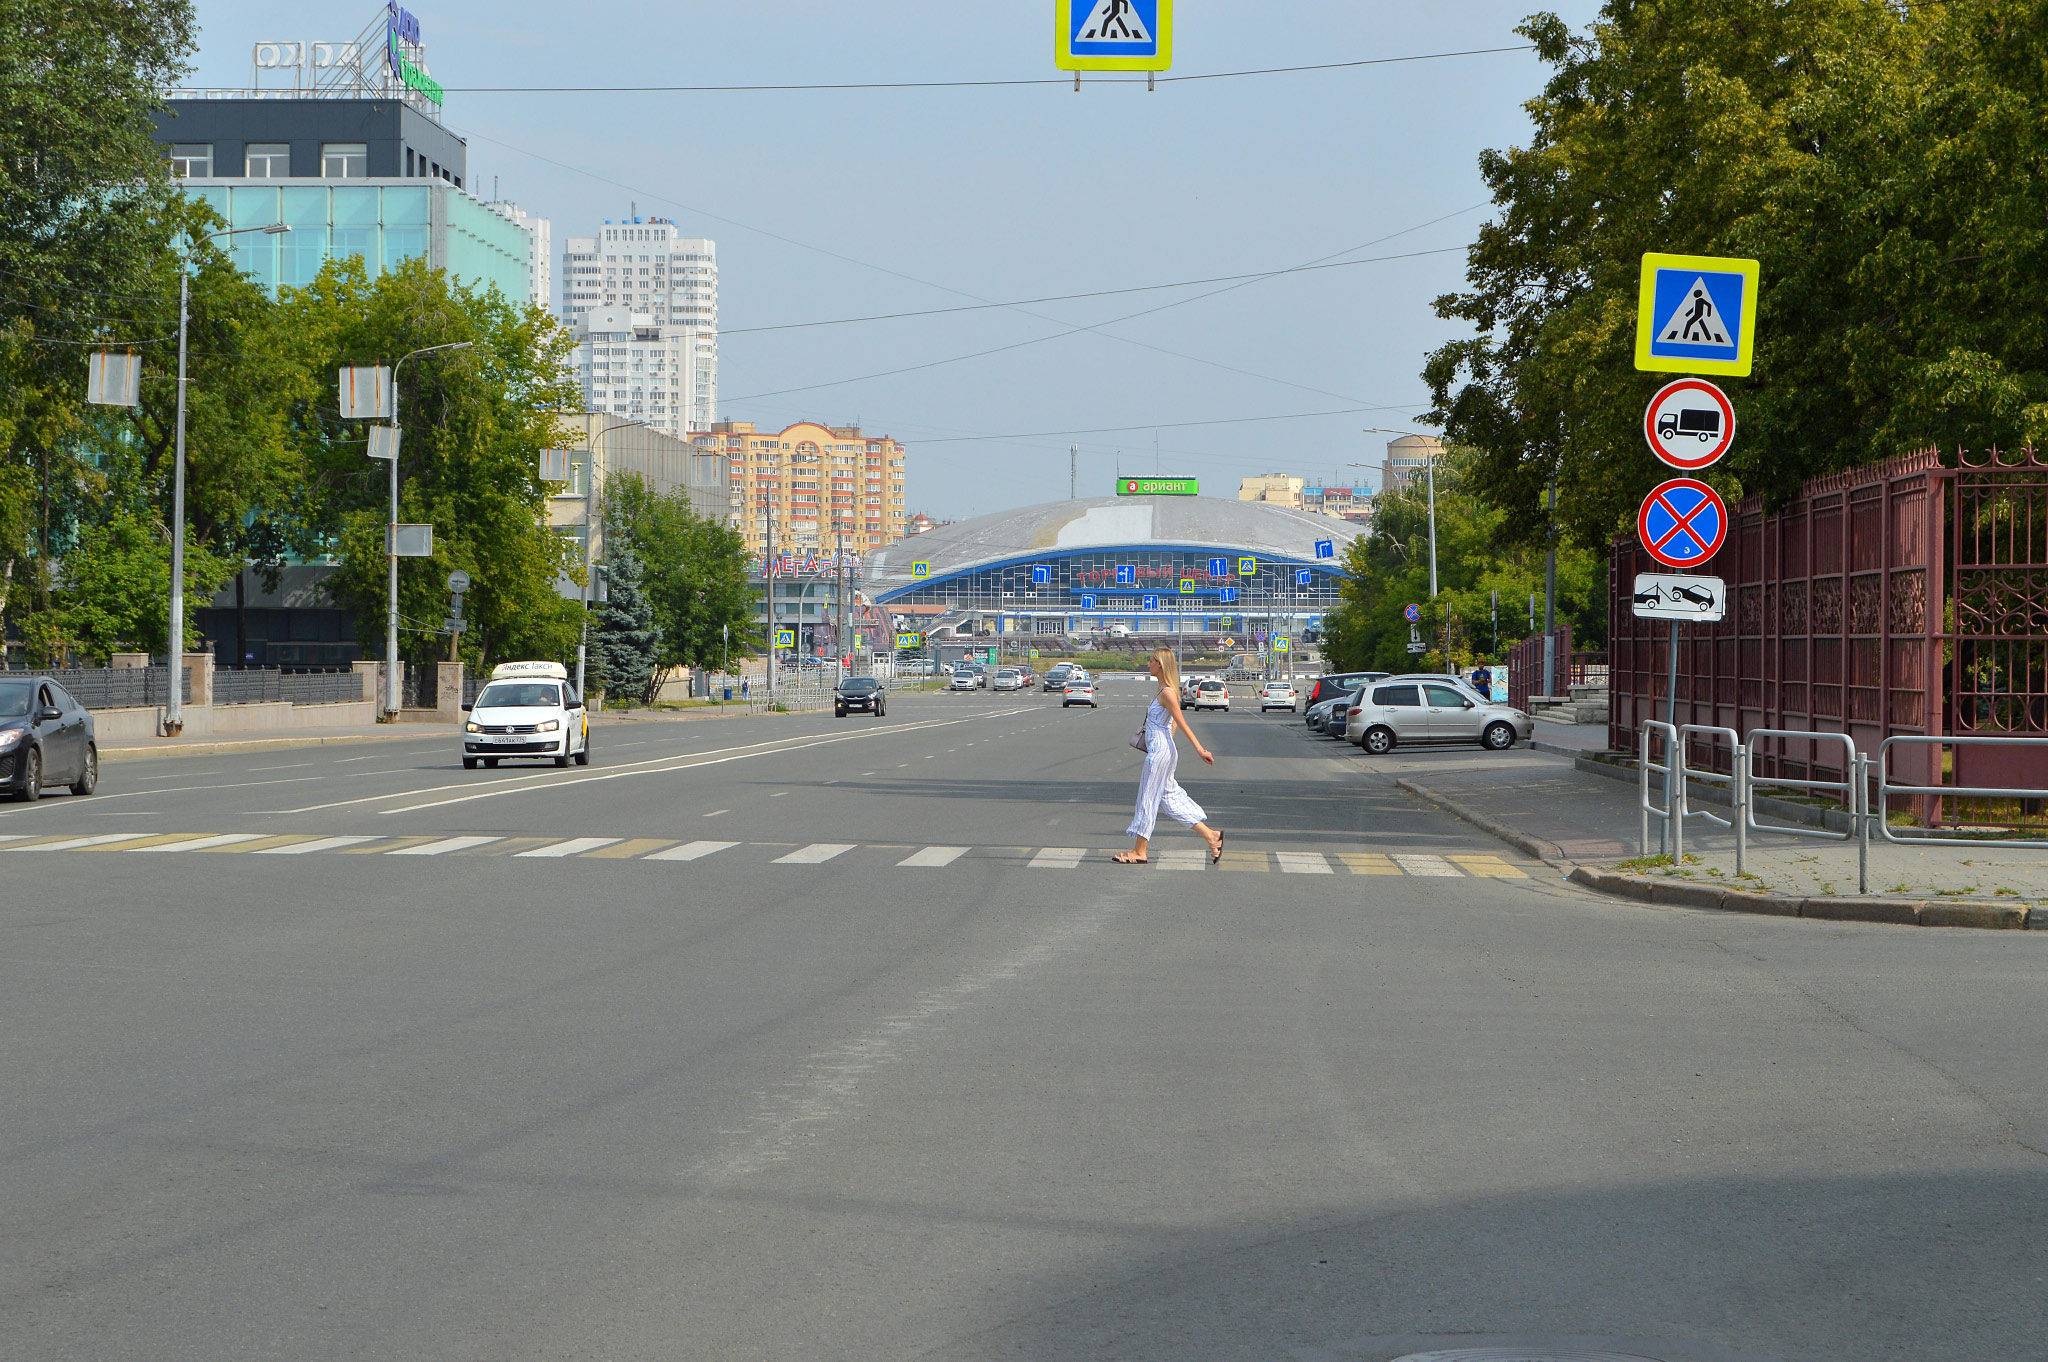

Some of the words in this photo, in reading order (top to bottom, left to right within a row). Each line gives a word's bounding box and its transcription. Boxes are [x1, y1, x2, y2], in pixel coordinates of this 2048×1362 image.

[1143, 482, 1187, 493] ариант
[762, 551, 864, 579] МЕГАПО
[1076, 563, 1173, 584] ТОРГВЫЙ
[1180, 567, 1236, 584] ЦЕНР
[501, 663, 530, 671] Яндекс
[531, 662, 553, 670] Такси
